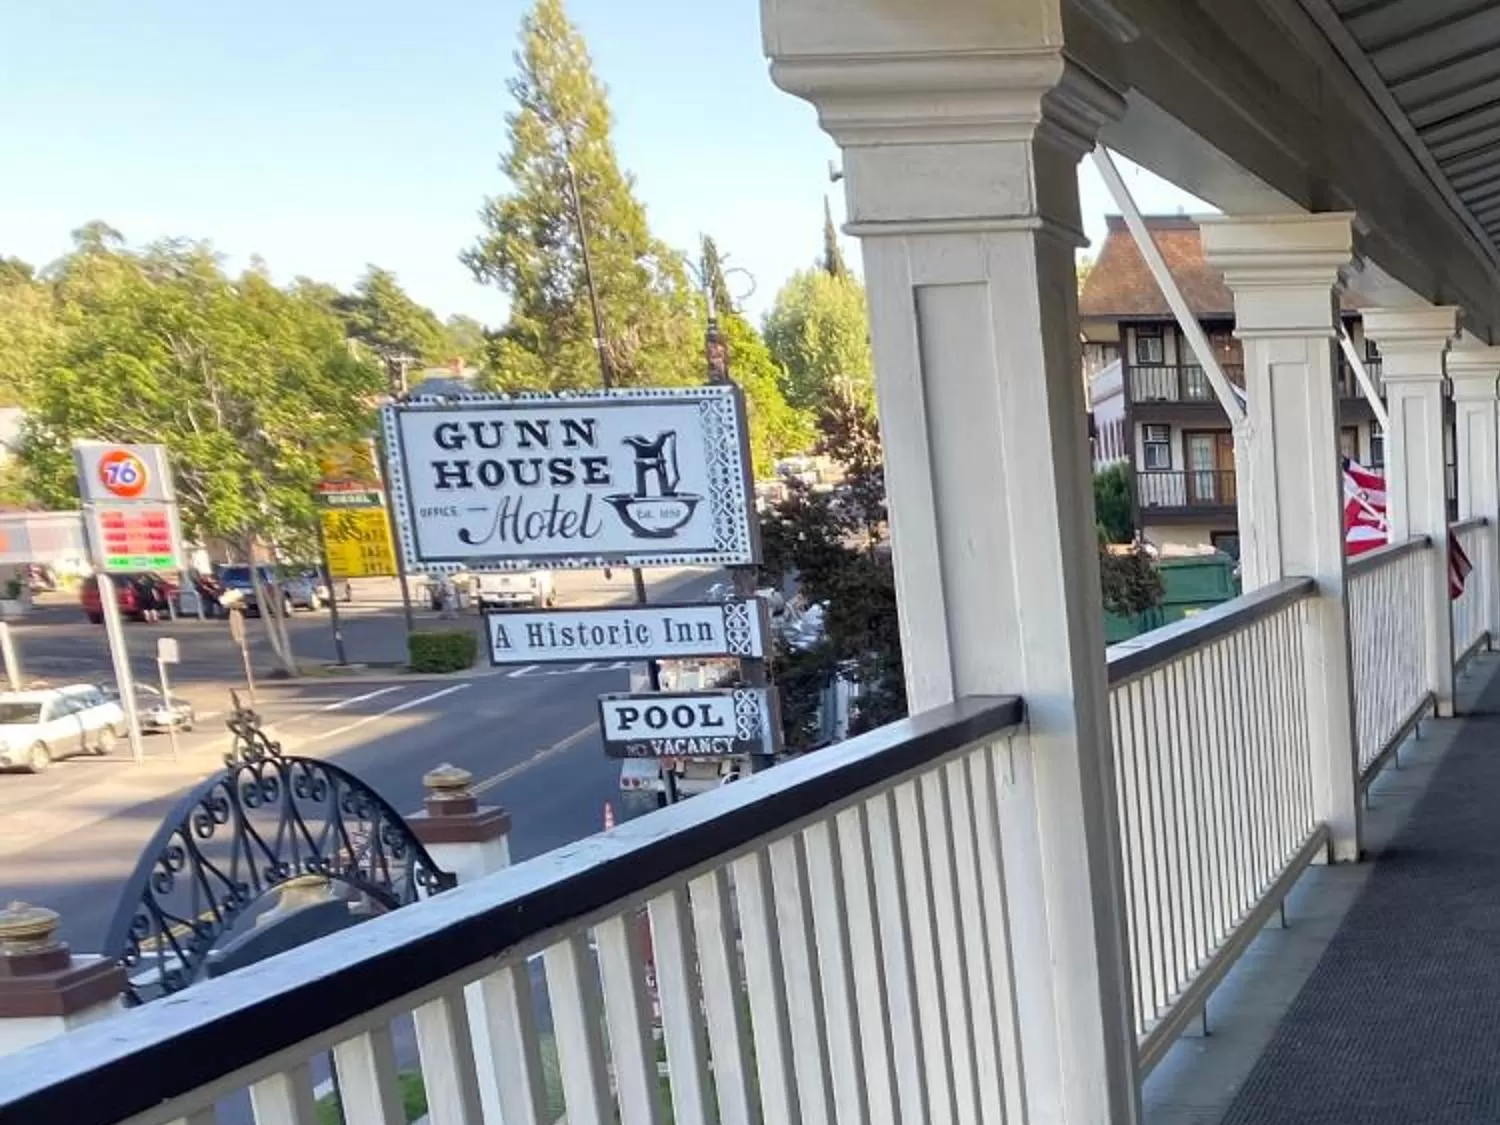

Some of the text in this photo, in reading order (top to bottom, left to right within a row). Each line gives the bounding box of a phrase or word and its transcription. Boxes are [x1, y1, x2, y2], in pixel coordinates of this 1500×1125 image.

[433, 417, 596, 450] GUNN
[104, 461, 137, 485] 76
[431, 456, 611, 489] HOUSE
[419, 506, 458, 518] OFFICE
[458, 492, 603, 545] Hotel
[495, 617, 714, 649] A Historic Inn
[615, 703, 724, 731] POOL
[650, 737, 735, 756] VACANCY
